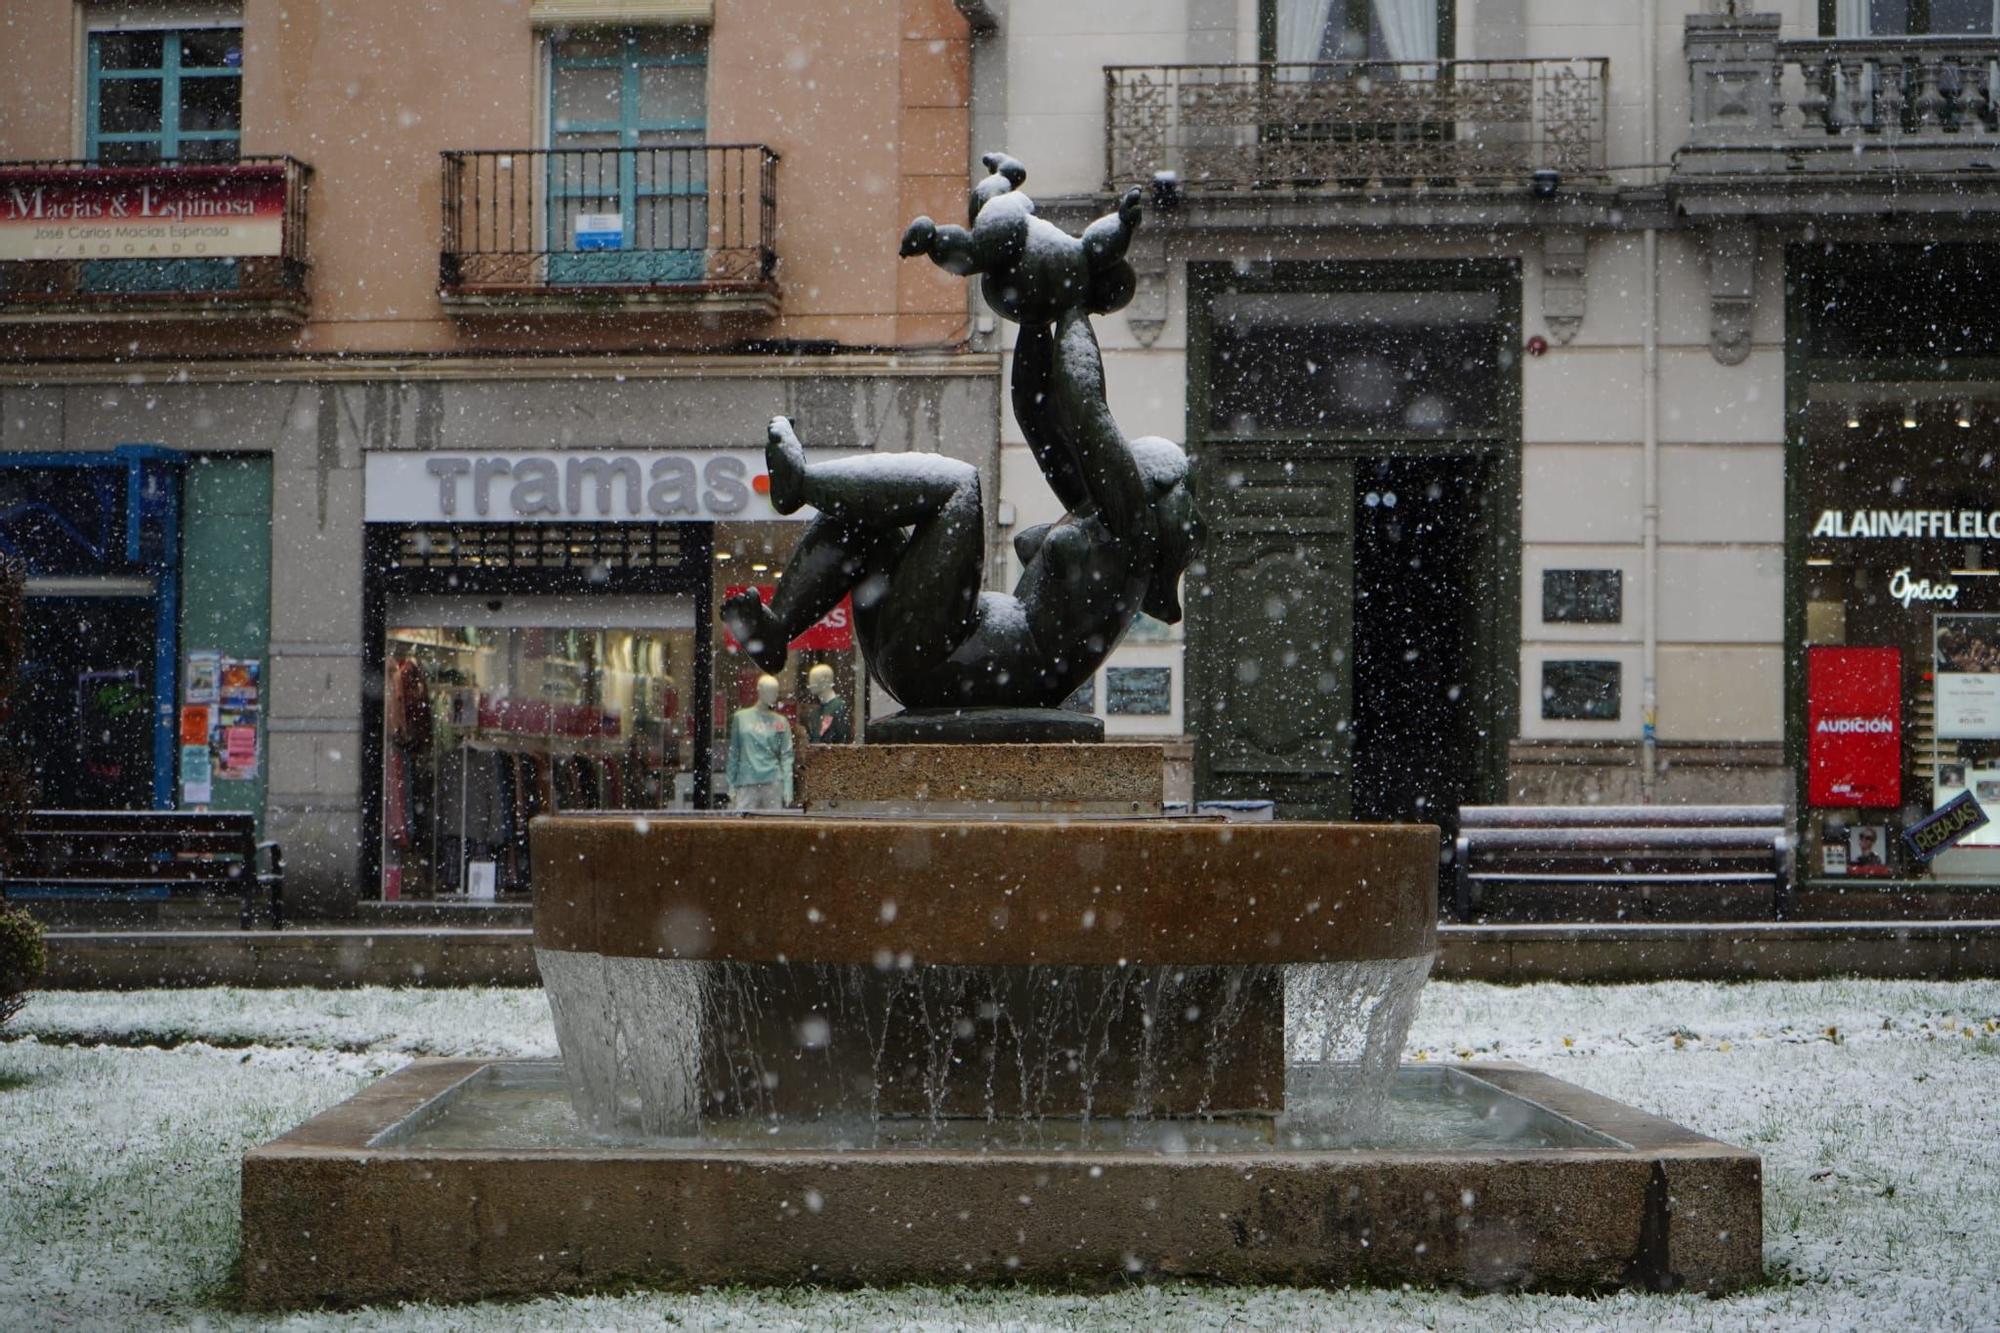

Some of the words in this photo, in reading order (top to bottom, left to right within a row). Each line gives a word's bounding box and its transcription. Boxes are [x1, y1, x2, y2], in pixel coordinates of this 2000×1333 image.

[109, 195, 129, 218] &
[139, 184, 256, 223] Espinosa
[33, 226, 64, 240] José
[68, 226, 113, 239] Carlos
[169, 225, 230, 240] Espinosa
[425, 455, 750, 516] Tramas
[1817, 717, 1893, 733] AUDICIÓN
[1914, 801, 1979, 850] REBAJAS
